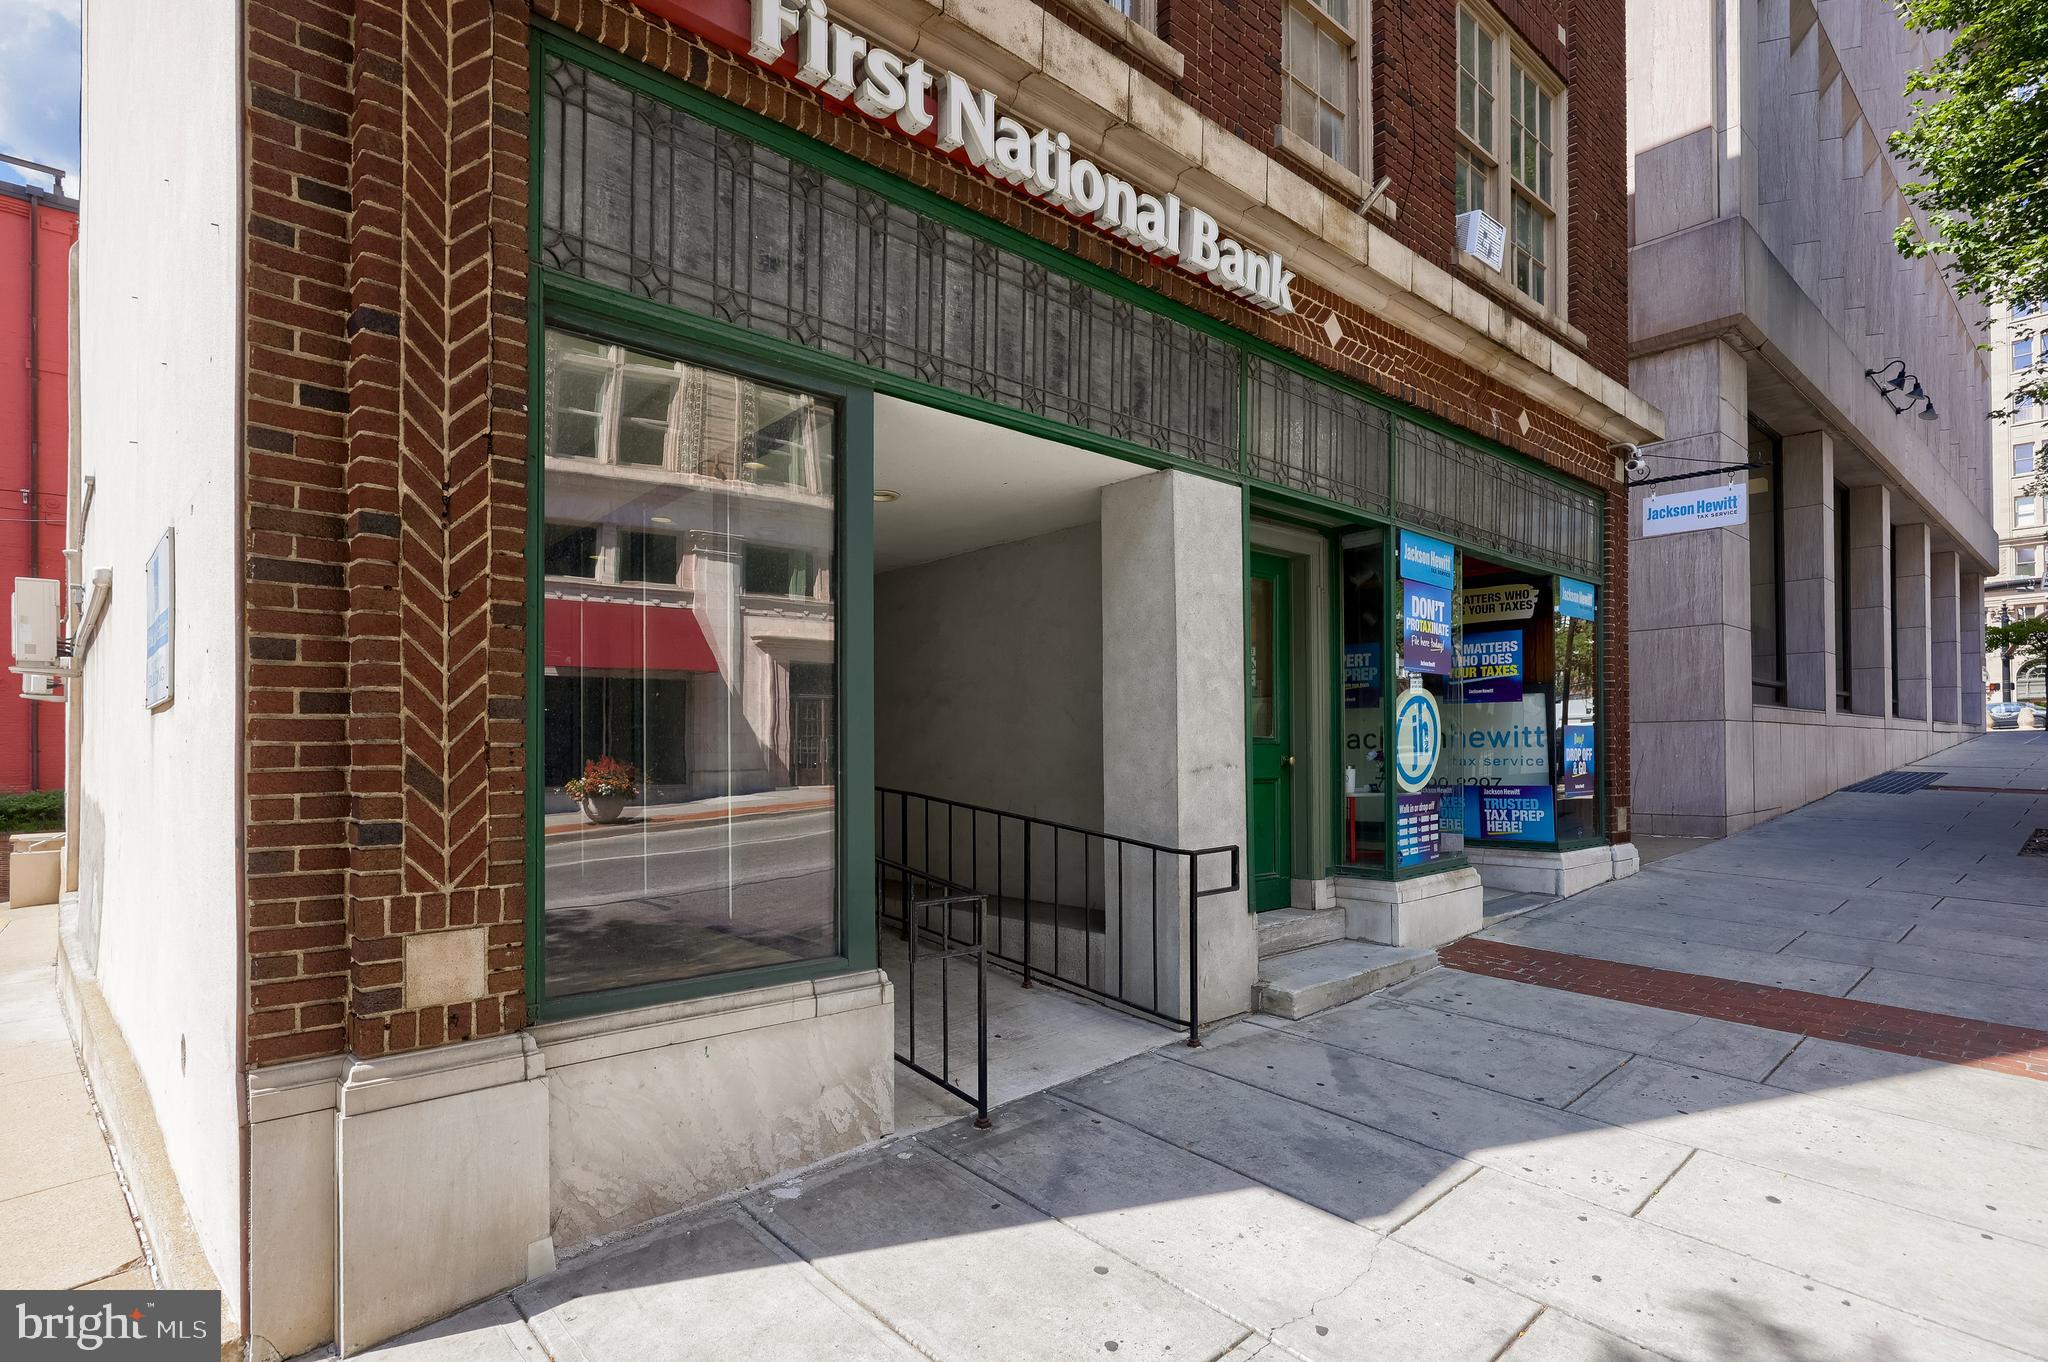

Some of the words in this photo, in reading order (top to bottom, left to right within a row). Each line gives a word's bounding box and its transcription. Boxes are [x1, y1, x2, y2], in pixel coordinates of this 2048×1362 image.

[749, 0, 934, 136] First
[935, 69, 1182, 259] National
[1177, 206, 1297, 316] Bank
[1647, 504, 1695, 521] Jackson
[1696, 495, 1738, 514] Hewitt
[1711, 509, 1738, 517] SERVICE
[1404, 543, 1430, 566] Jackson
[1430, 550, 1451, 572] Hewitt
[1462, 592, 1501, 604] ATTERS
[1504, 589, 1530, 600] WHO
[1411, 595, 1445, 622] DON'T
[1469, 604, 1496, 615] YOUR
[1499, 600, 1533, 612] TAXES
[1406, 617, 1449, 637] PROTAXINATE
[1463, 640, 1518, 655] MATTERS
[1481, 652, 1513, 665] DOES
[1345, 667, 1378, 682] PREP
[1480, 664, 1518, 677] TAXES
[1483, 755, 1544, 767] service
[1565, 747, 1582, 762] DROP
[1582, 747, 1593, 762] OFF
[1399, 804, 1410, 815] Walk
[1410, 804, 1415, 813] in
[1419, 803, 1428, 813] drop
[1484, 798, 1539, 810] TRUSTED
[1441, 806, 1462, 819] ONE
[1484, 809, 1509, 821] TAX
[1511, 810, 1545, 822] PREP
[1486, 821, 1523, 833] HERE!
